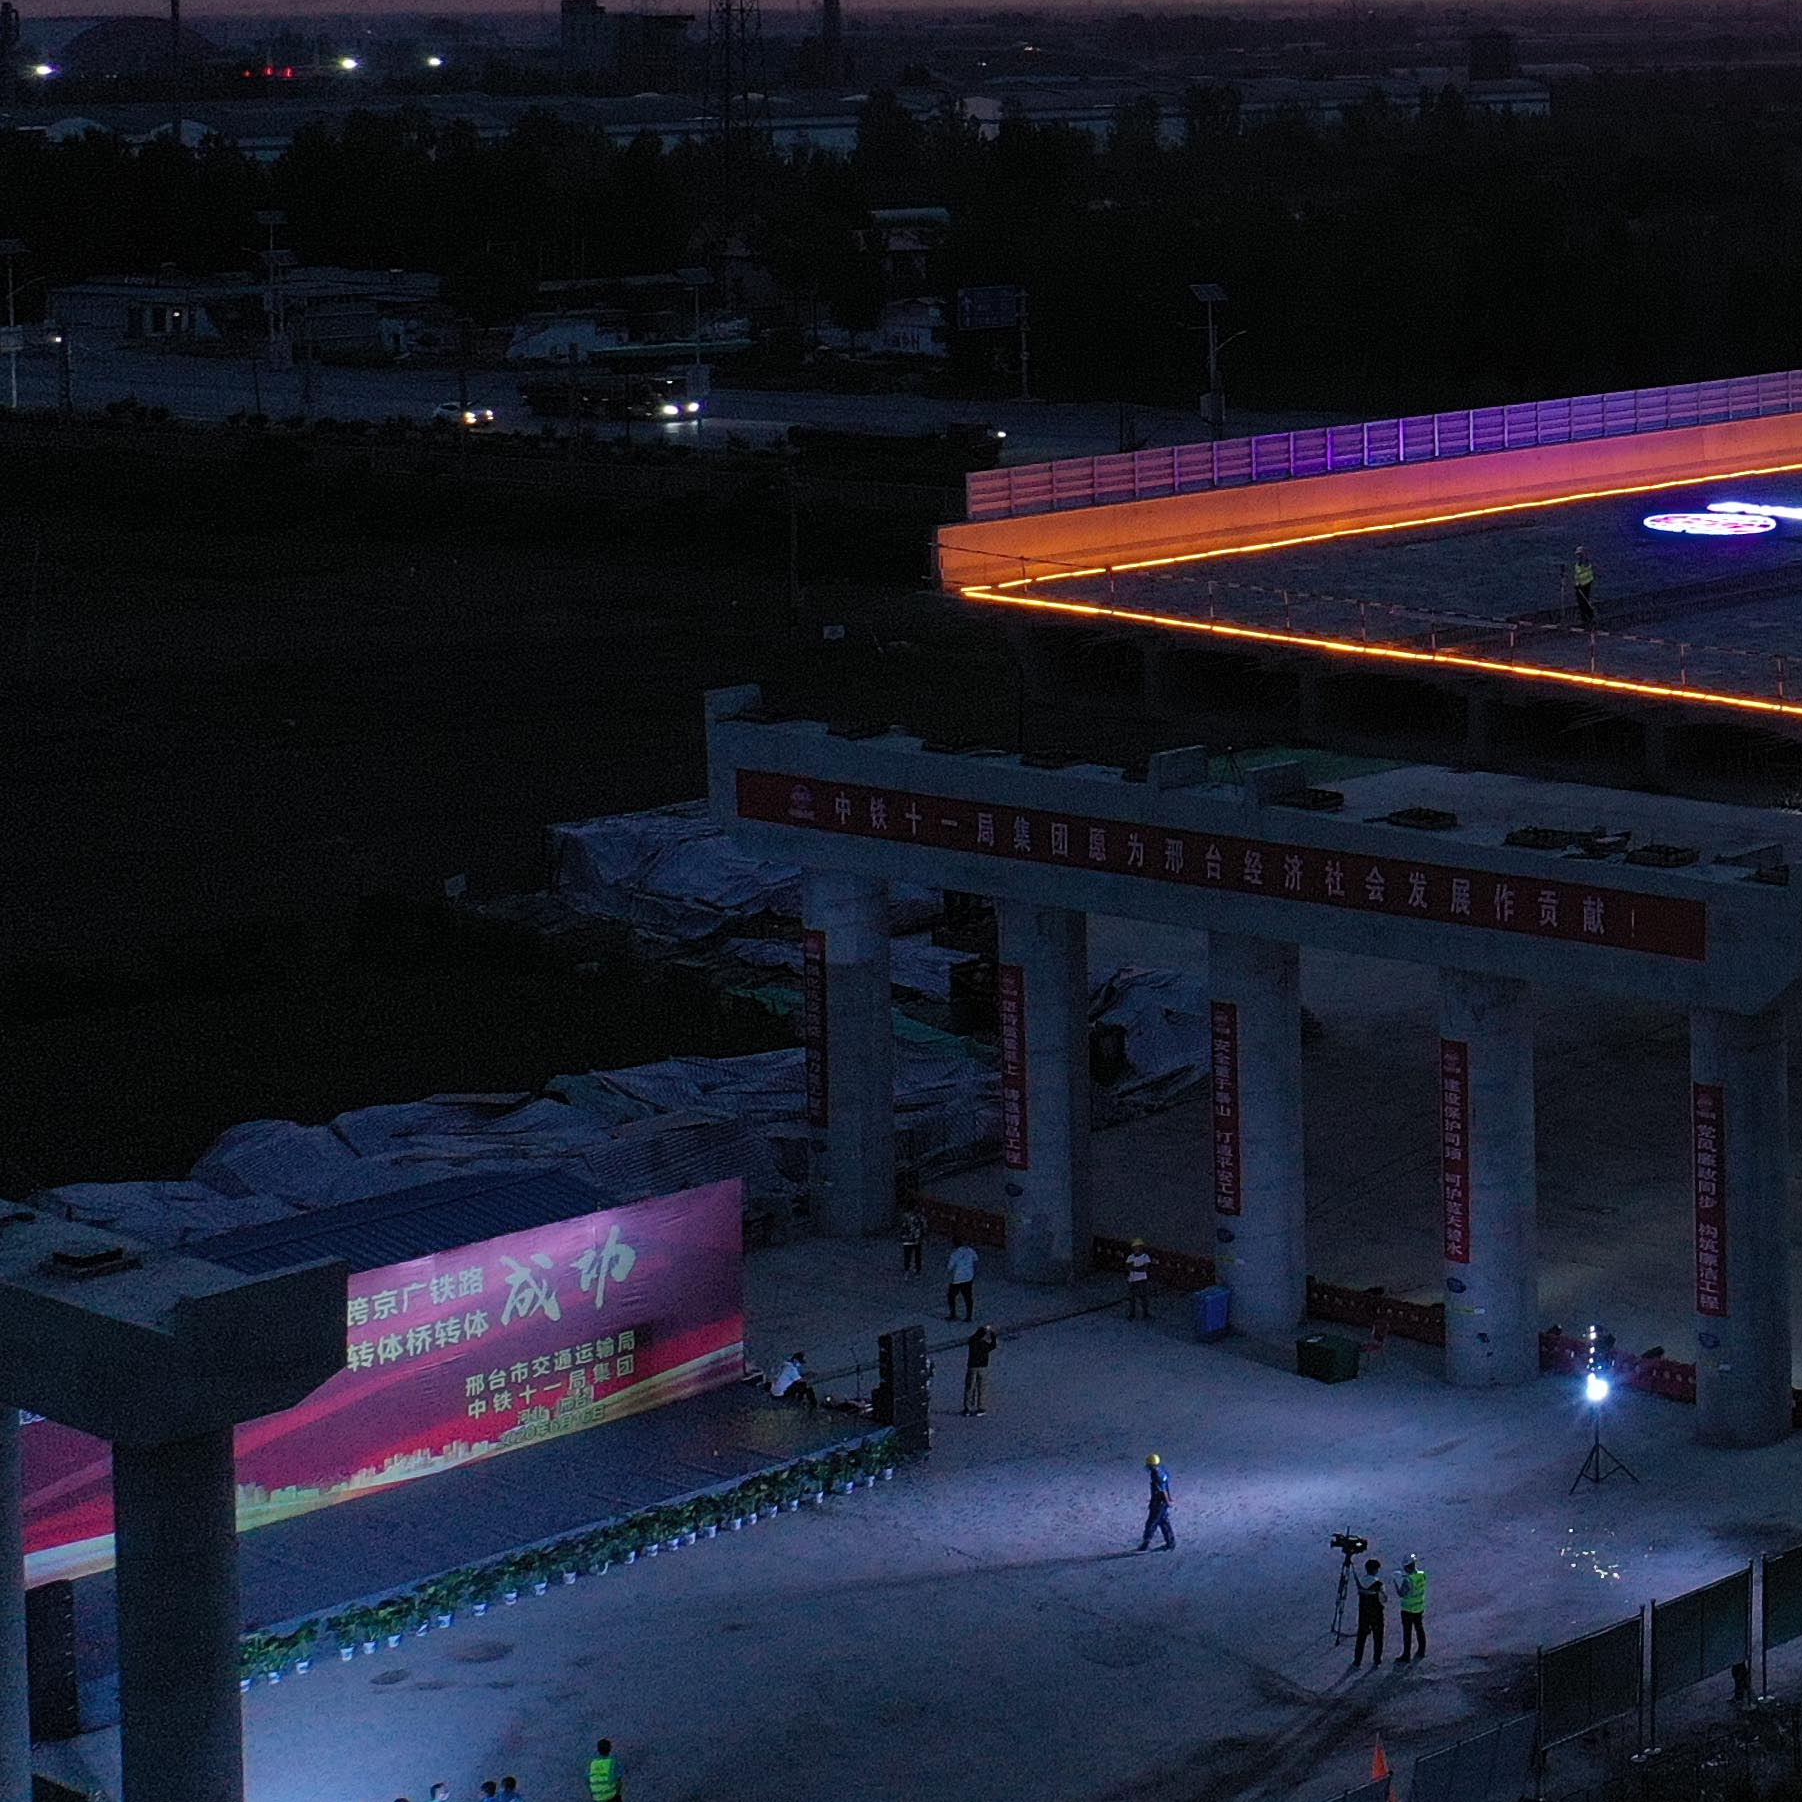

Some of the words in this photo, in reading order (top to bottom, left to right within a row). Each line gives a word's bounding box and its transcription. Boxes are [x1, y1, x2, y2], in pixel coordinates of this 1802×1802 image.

[347, 1266, 485, 1329] 跨京广铁路
[501, 1224, 637, 1326] 成功
[347, 1309, 489, 1374] 转体桥转体
[465, 1332, 636, 1398] 邢台市交通运输局
[468, 1354, 635, 1420] 中铁十一局集团
